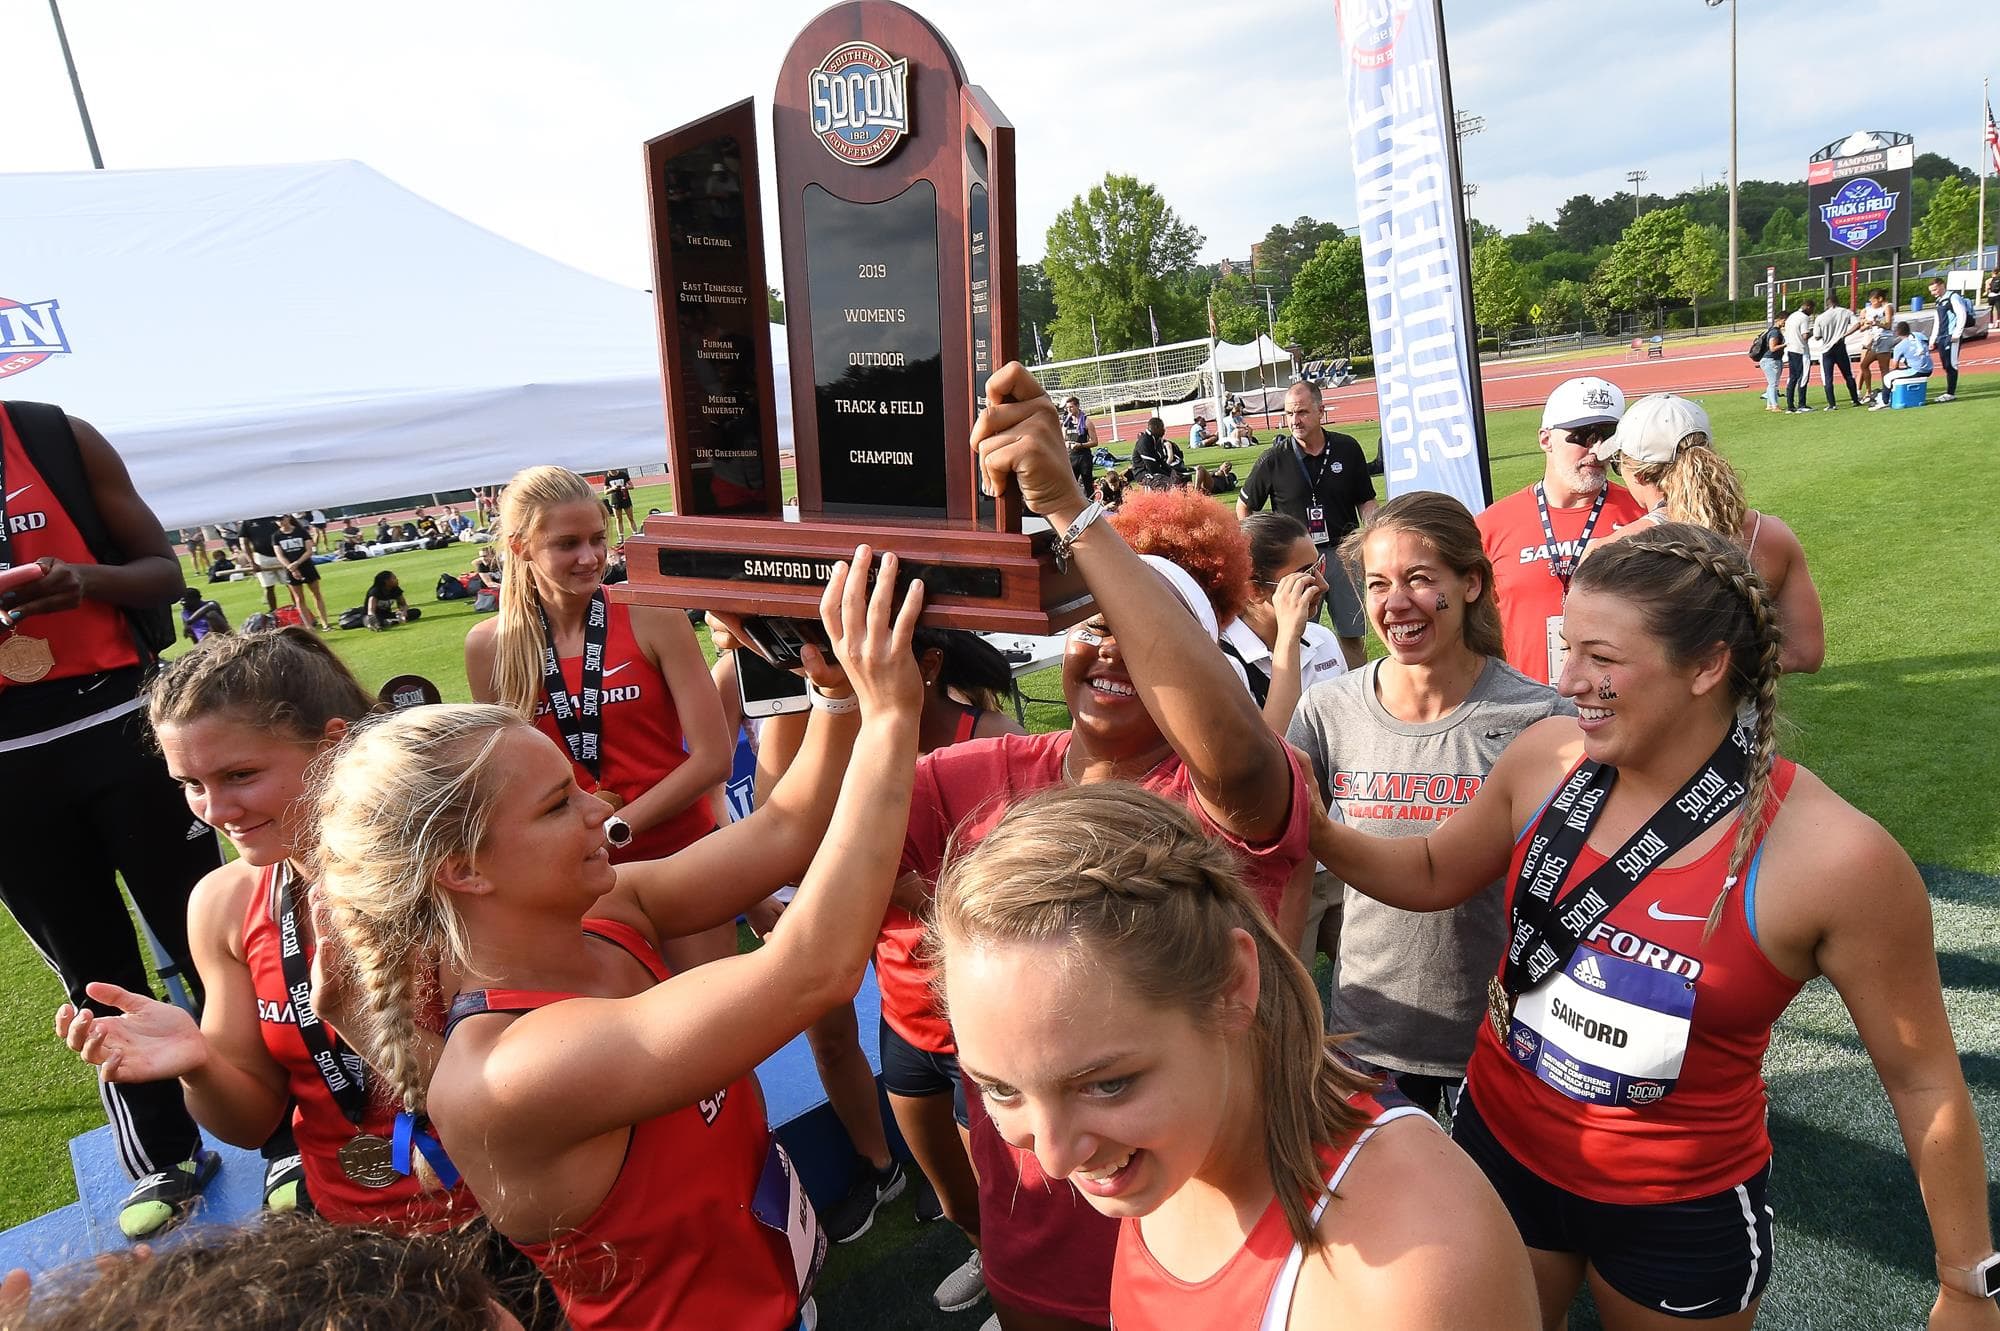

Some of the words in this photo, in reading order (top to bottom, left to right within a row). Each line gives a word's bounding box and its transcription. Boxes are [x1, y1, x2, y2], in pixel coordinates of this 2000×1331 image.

[830, 50, 882, 72] SOUTHERN
[811, 64, 904, 133] SOCON
[829, 131, 891, 157] CONFERENCE
[850, 131, 870, 140] 1921
[1832, 161, 1887, 179] UNIVERSITY
[1836, 153, 1882, 169] SAMFORD
[1826, 203, 1857, 219] TRACK
[1866, 197, 1892, 213] FIELD
[687, 235, 702, 246] THE
[703, 236, 732, 248] CITADEL
[858, 264, 887, 279] 2019
[682, 281, 702, 293] EAST
[704, 282, 744, 295] TENNESSEE
[680, 293, 702, 304] STATE
[703, 294, 747, 306] UNIVERSITY
[844, 308, 906, 323] WOMEN'S
[697, 350, 740, 361] UNIVERSITY
[703, 339, 733, 350] FURMAN
[849, 352, 905, 367] OUTDOOR
[702, 405, 744, 416] UNIVERSITY
[708, 394, 737, 405] MERCER
[835, 399, 876, 414] TRACK
[879, 400, 888, 415] &
[890, 399, 924, 416] FIELD
[696, 448, 713, 459] UNC
[714, 449, 758, 459] GREENSBORO
[850, 450, 914, 466] CHAMPION
[744, 558, 811, 580] SAMFORD
[588, 598, 605, 628] SOCON
[584, 642, 602, 672] SOCON
[550, 690, 573, 720] SOCON
[582, 687, 599, 717] SOCON
[582, 731, 598, 760] SOCON
[1333, 771, 1486, 805] SAMFOR
[1552, 770, 1592, 813] SOCON
[1675, 767, 1728, 821] SOCON
[1350, 803, 1394, 820] TRACK
[1395, 805, 1434, 822] AND
[1564, 788, 1604, 832] SOCON
[1521, 834, 1549, 879] SOCON
[1616, 828, 1669, 882] SOCON
[1528, 853, 1568, 903] SOCON
[1560, 886, 1609, 938] SOCON
[281, 911, 300, 958] SOCON
[1508, 919, 1535, 966] SOCON
[1587, 922, 1702, 980] FORD
[1573, 968, 1607, 990] adidas
[289, 982, 319, 1028] SOCON
[314, 1050, 350, 1092] SOCON
[1567, 1068, 1611, 1089] CONFERENCE
[1563, 1072, 1584, 1088] TRACK
[1590, 1085, 1611, 1096] FIELD
[1626, 1084, 1666, 1099] SOCON
